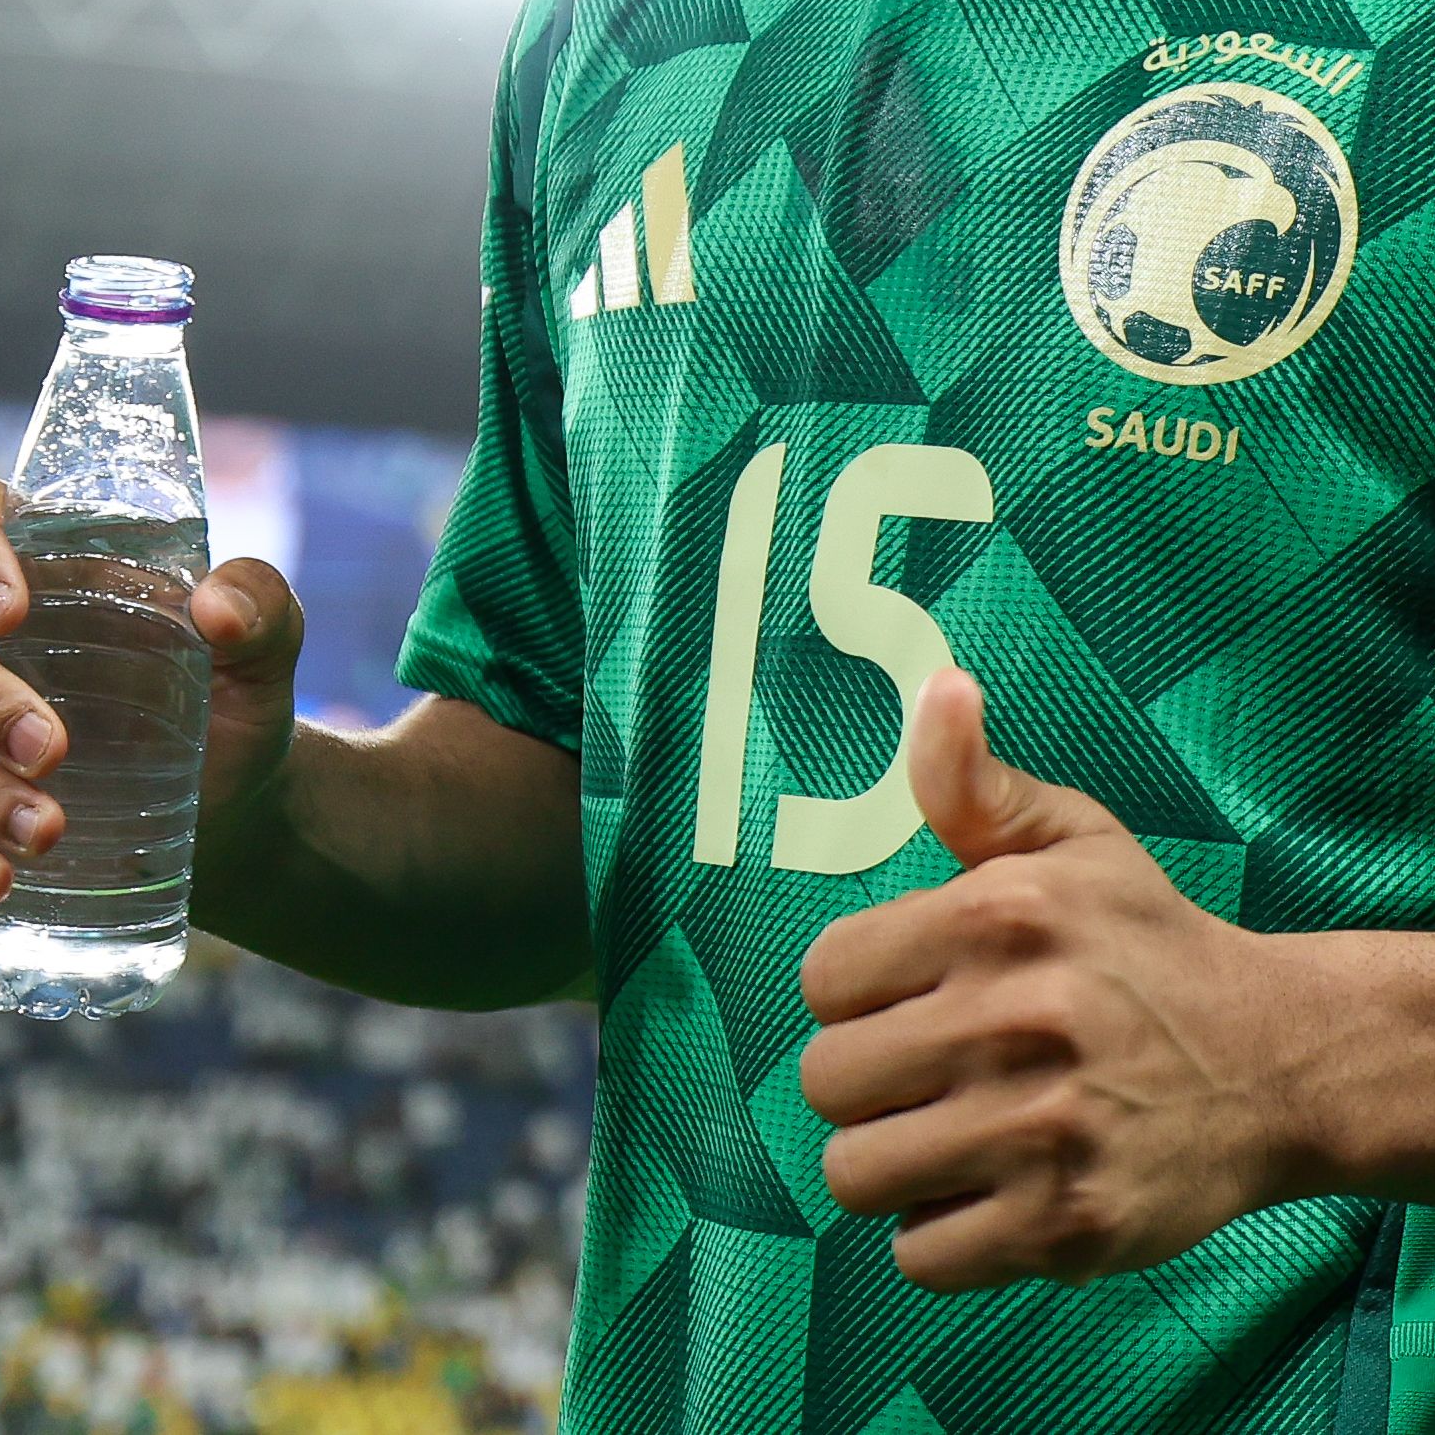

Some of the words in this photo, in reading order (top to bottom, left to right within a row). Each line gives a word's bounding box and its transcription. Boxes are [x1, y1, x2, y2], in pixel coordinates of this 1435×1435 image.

[1143, 30, 1362, 96] السعودية
[1199, 265, 1286, 300] SAFF
[1084, 407, 1241, 465] SAUDI
[693, 442, 994, 875] 15
